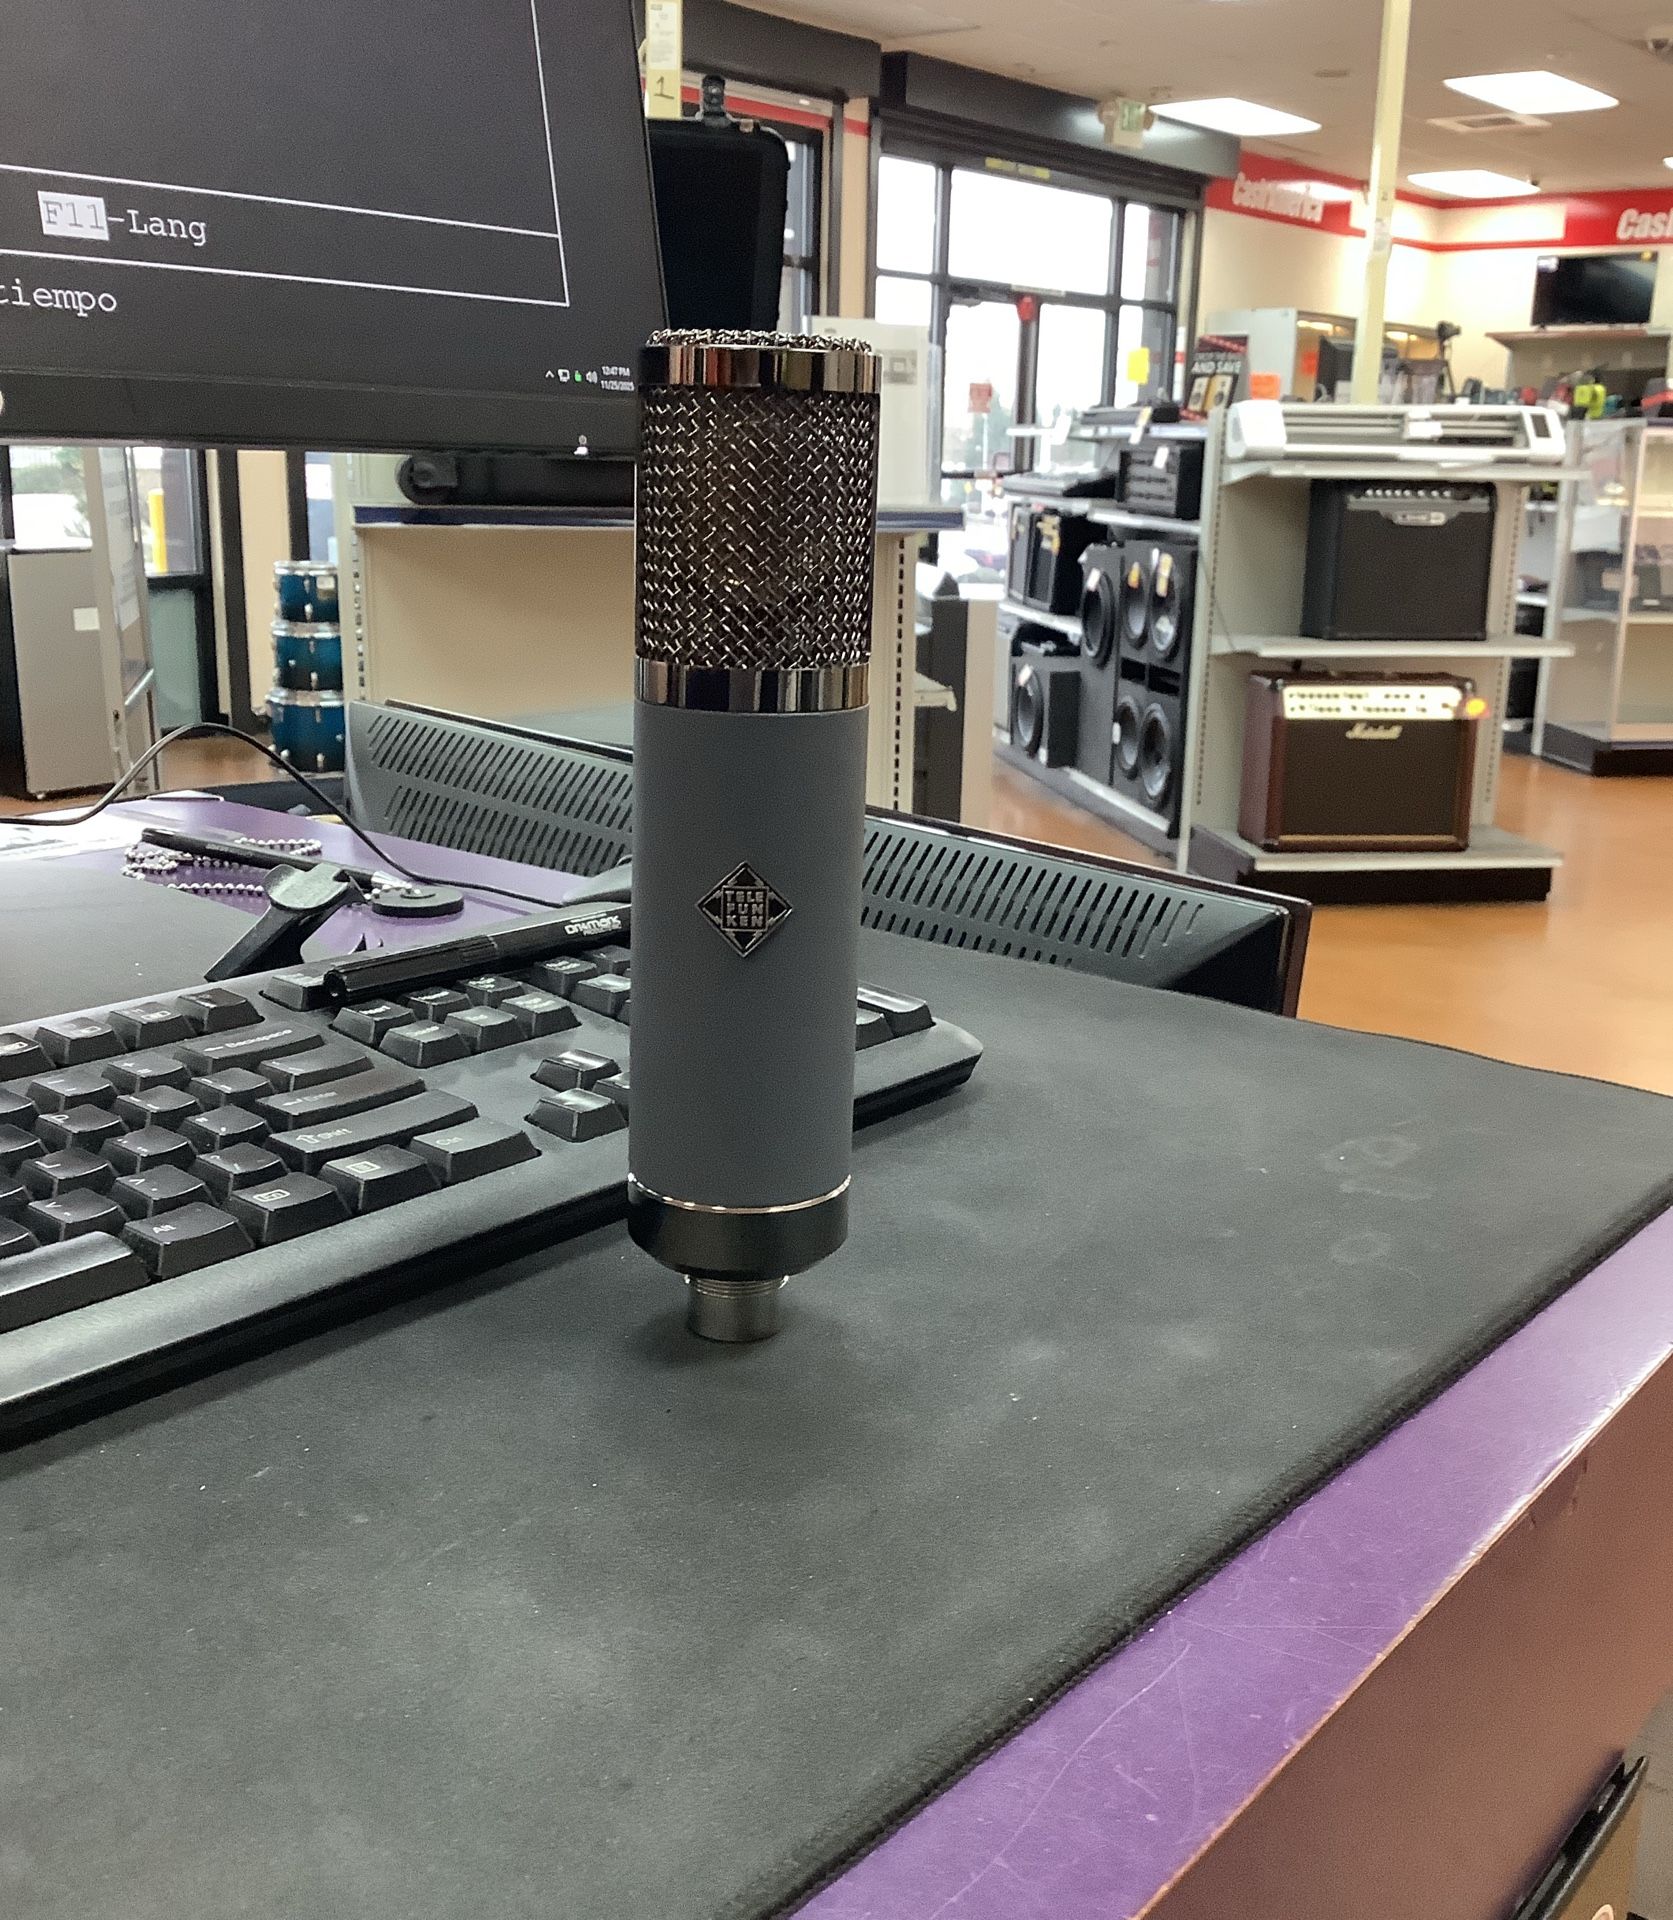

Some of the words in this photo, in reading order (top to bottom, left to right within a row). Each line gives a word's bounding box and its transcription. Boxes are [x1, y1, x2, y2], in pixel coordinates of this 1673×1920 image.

[653, 75, 675, 99] 1
[1616, 207, 1673, 240] Cas
[725, 891, 764, 903] TELE
[726, 902, 764, 915] FUN
[726, 914, 763, 927] KEN
